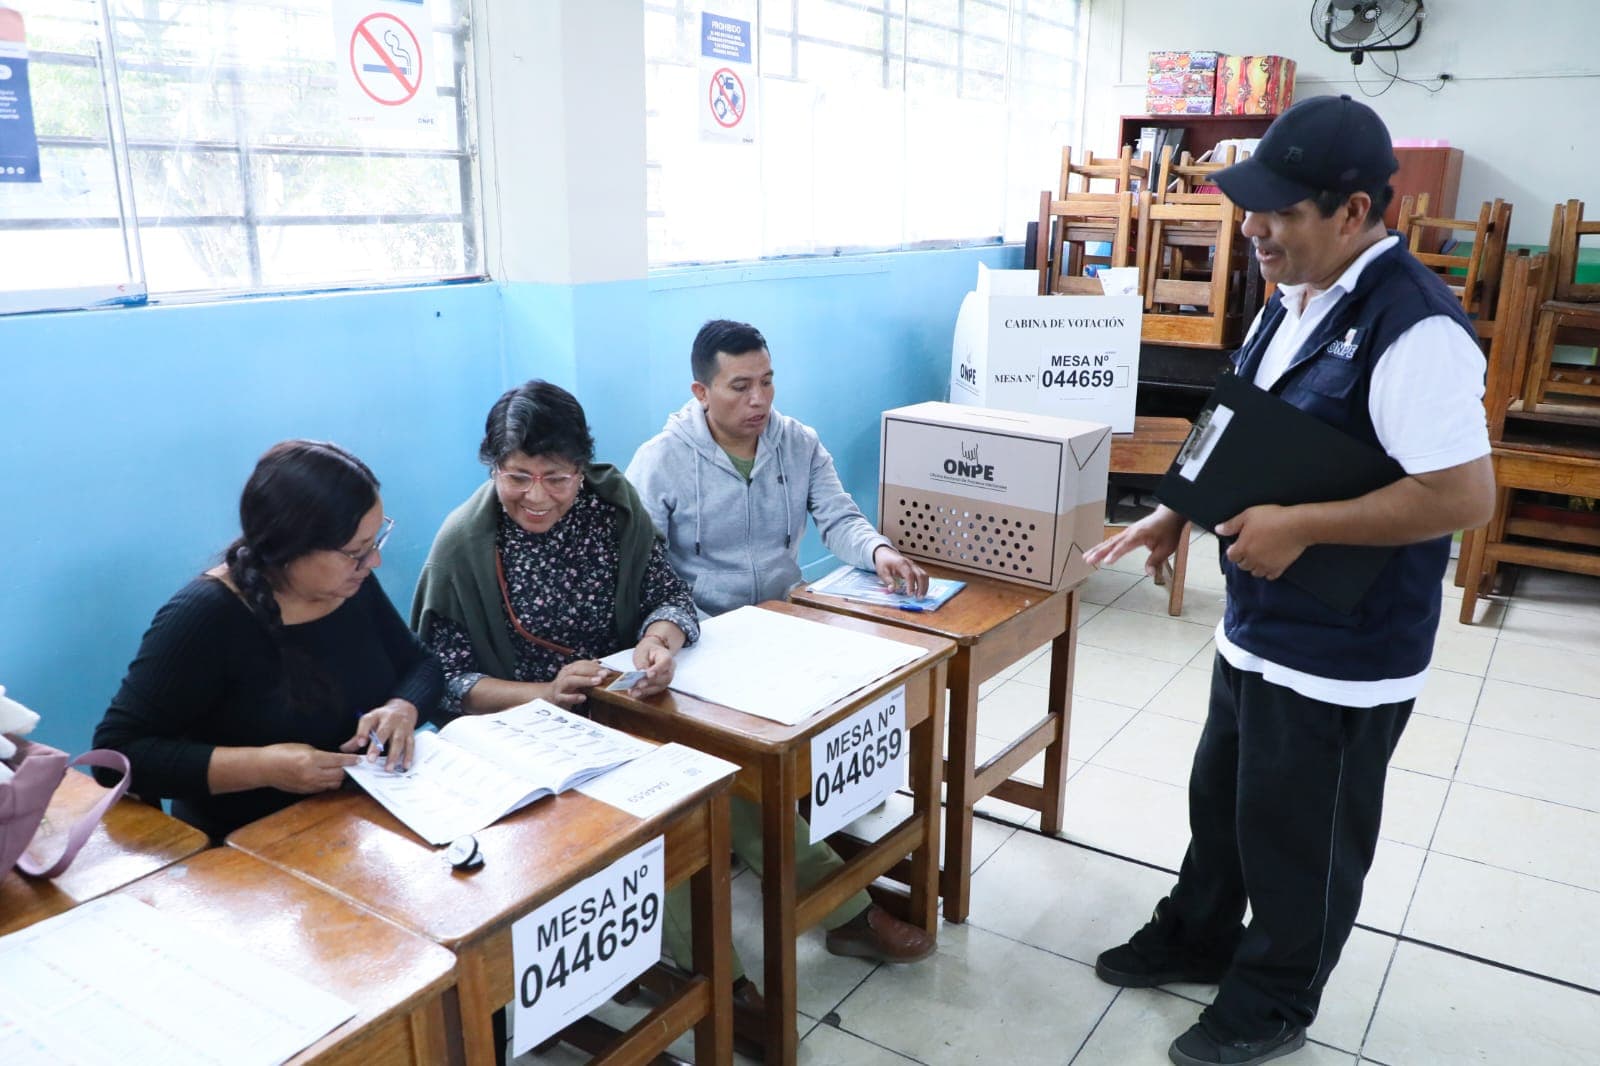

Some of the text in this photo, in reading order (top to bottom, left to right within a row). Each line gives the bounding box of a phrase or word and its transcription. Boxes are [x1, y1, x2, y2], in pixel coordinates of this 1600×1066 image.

[1005, 316, 1125, 329] CABINA DE VOTACIÓN
[1051, 355, 1090, 367] MESA
[960, 363, 977, 386] ONPE
[994, 374, 1022, 384] MESA
[1042, 369, 1114, 388] 044659
[943, 458, 995, 482] ONPE
[826, 718, 873, 764] MESA
[815, 727, 902, 807] 044659
[537, 888, 616, 953] MESA
[520, 892, 659, 1009] 044659
